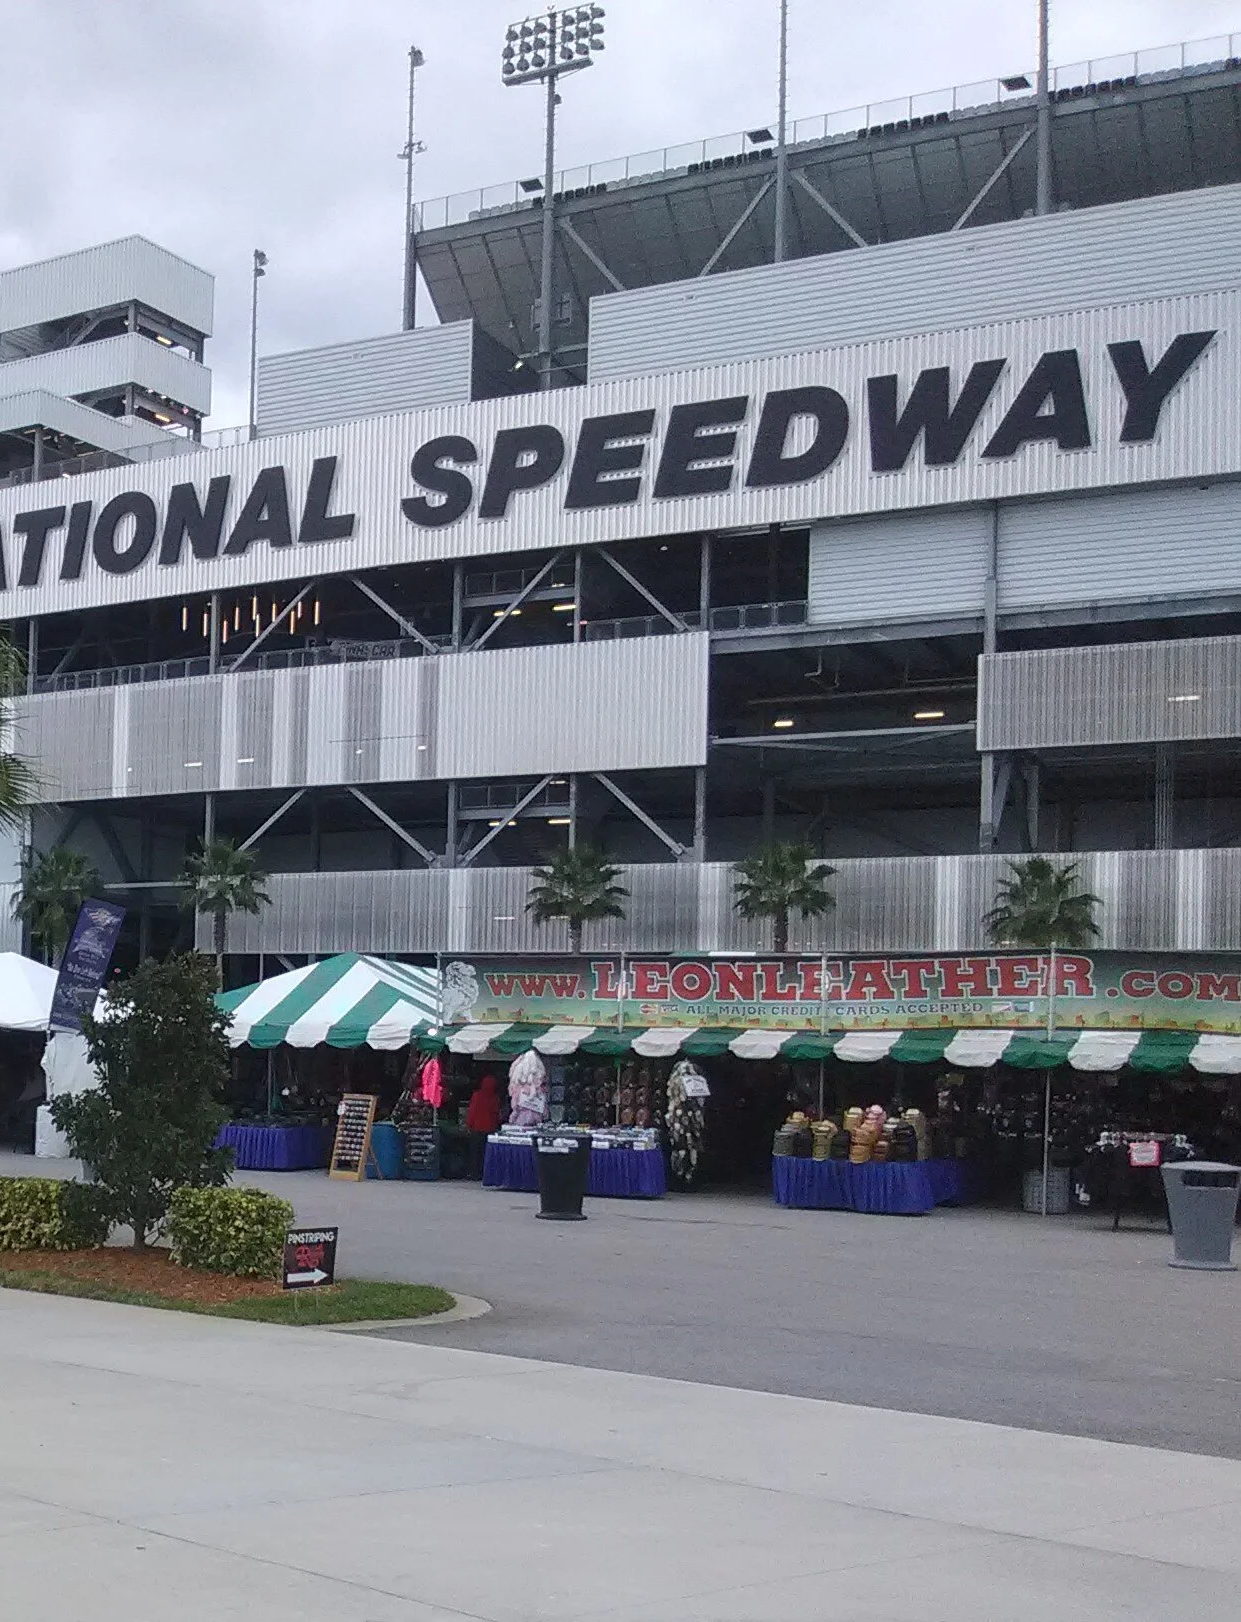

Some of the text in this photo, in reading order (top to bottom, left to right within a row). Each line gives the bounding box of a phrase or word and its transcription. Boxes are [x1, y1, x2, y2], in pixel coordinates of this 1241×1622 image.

[400, 329, 1219, 528] SPEEDWAY
[686, 1005, 711, 1014] ALL
[719, 1005, 767, 1016] MAJOR
[771, 1005, 823, 1015] CREDIT
[835, 1005, 890, 1015] CARDS
[895, 1003, 984, 1014] ACCEPTED
[287, 1231, 335, 1245] PINSTRIPING
